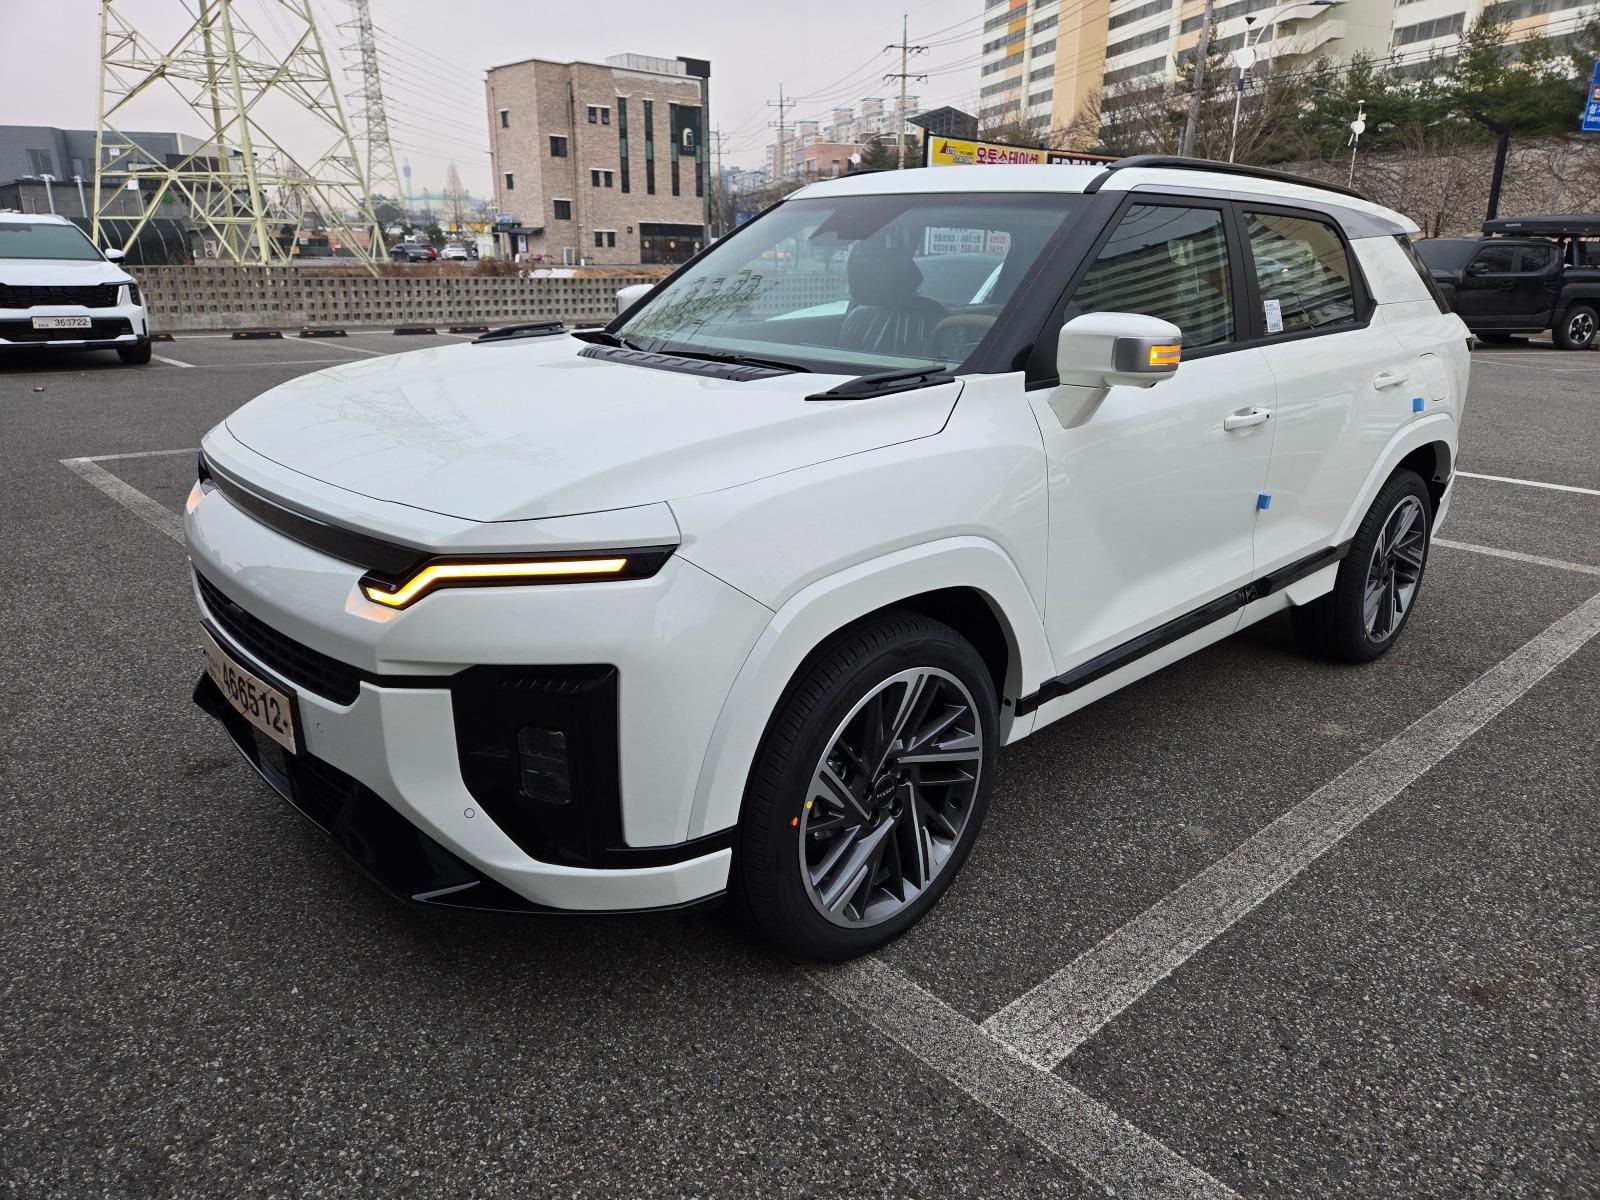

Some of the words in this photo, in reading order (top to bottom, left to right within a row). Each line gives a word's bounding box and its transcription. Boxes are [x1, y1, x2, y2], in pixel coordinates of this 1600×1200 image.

[976, 147, 1039, 165] 오토스테이션
[54, 318, 88, 327] 363722
[222, 661, 284, 735] 466512
